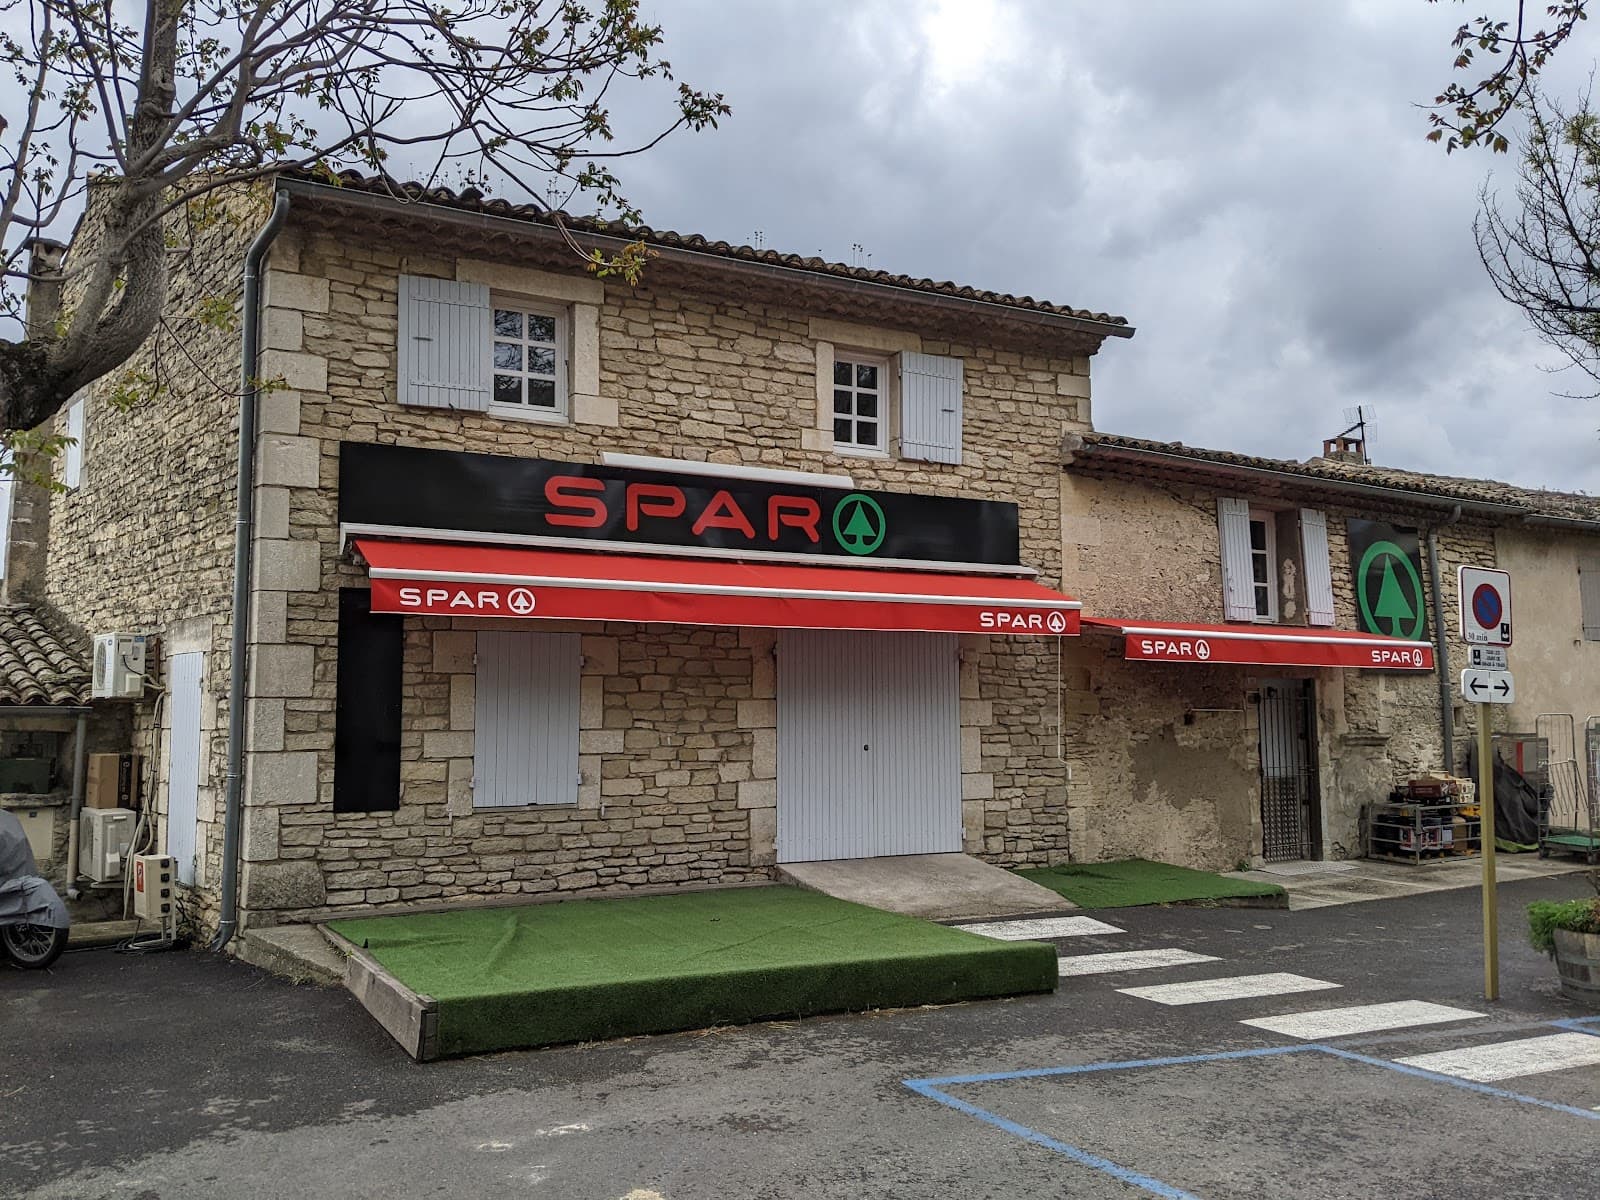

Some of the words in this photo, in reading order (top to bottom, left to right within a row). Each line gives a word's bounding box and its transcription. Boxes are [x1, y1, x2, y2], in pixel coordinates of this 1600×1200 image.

[544, 475, 820, 543] SPAR
[399, 587, 500, 609] SPAR
[980, 611, 1042, 629] SPAR
[1141, 640, 1192, 656] SPAR
[1371, 650, 1411, 663] SPAR
